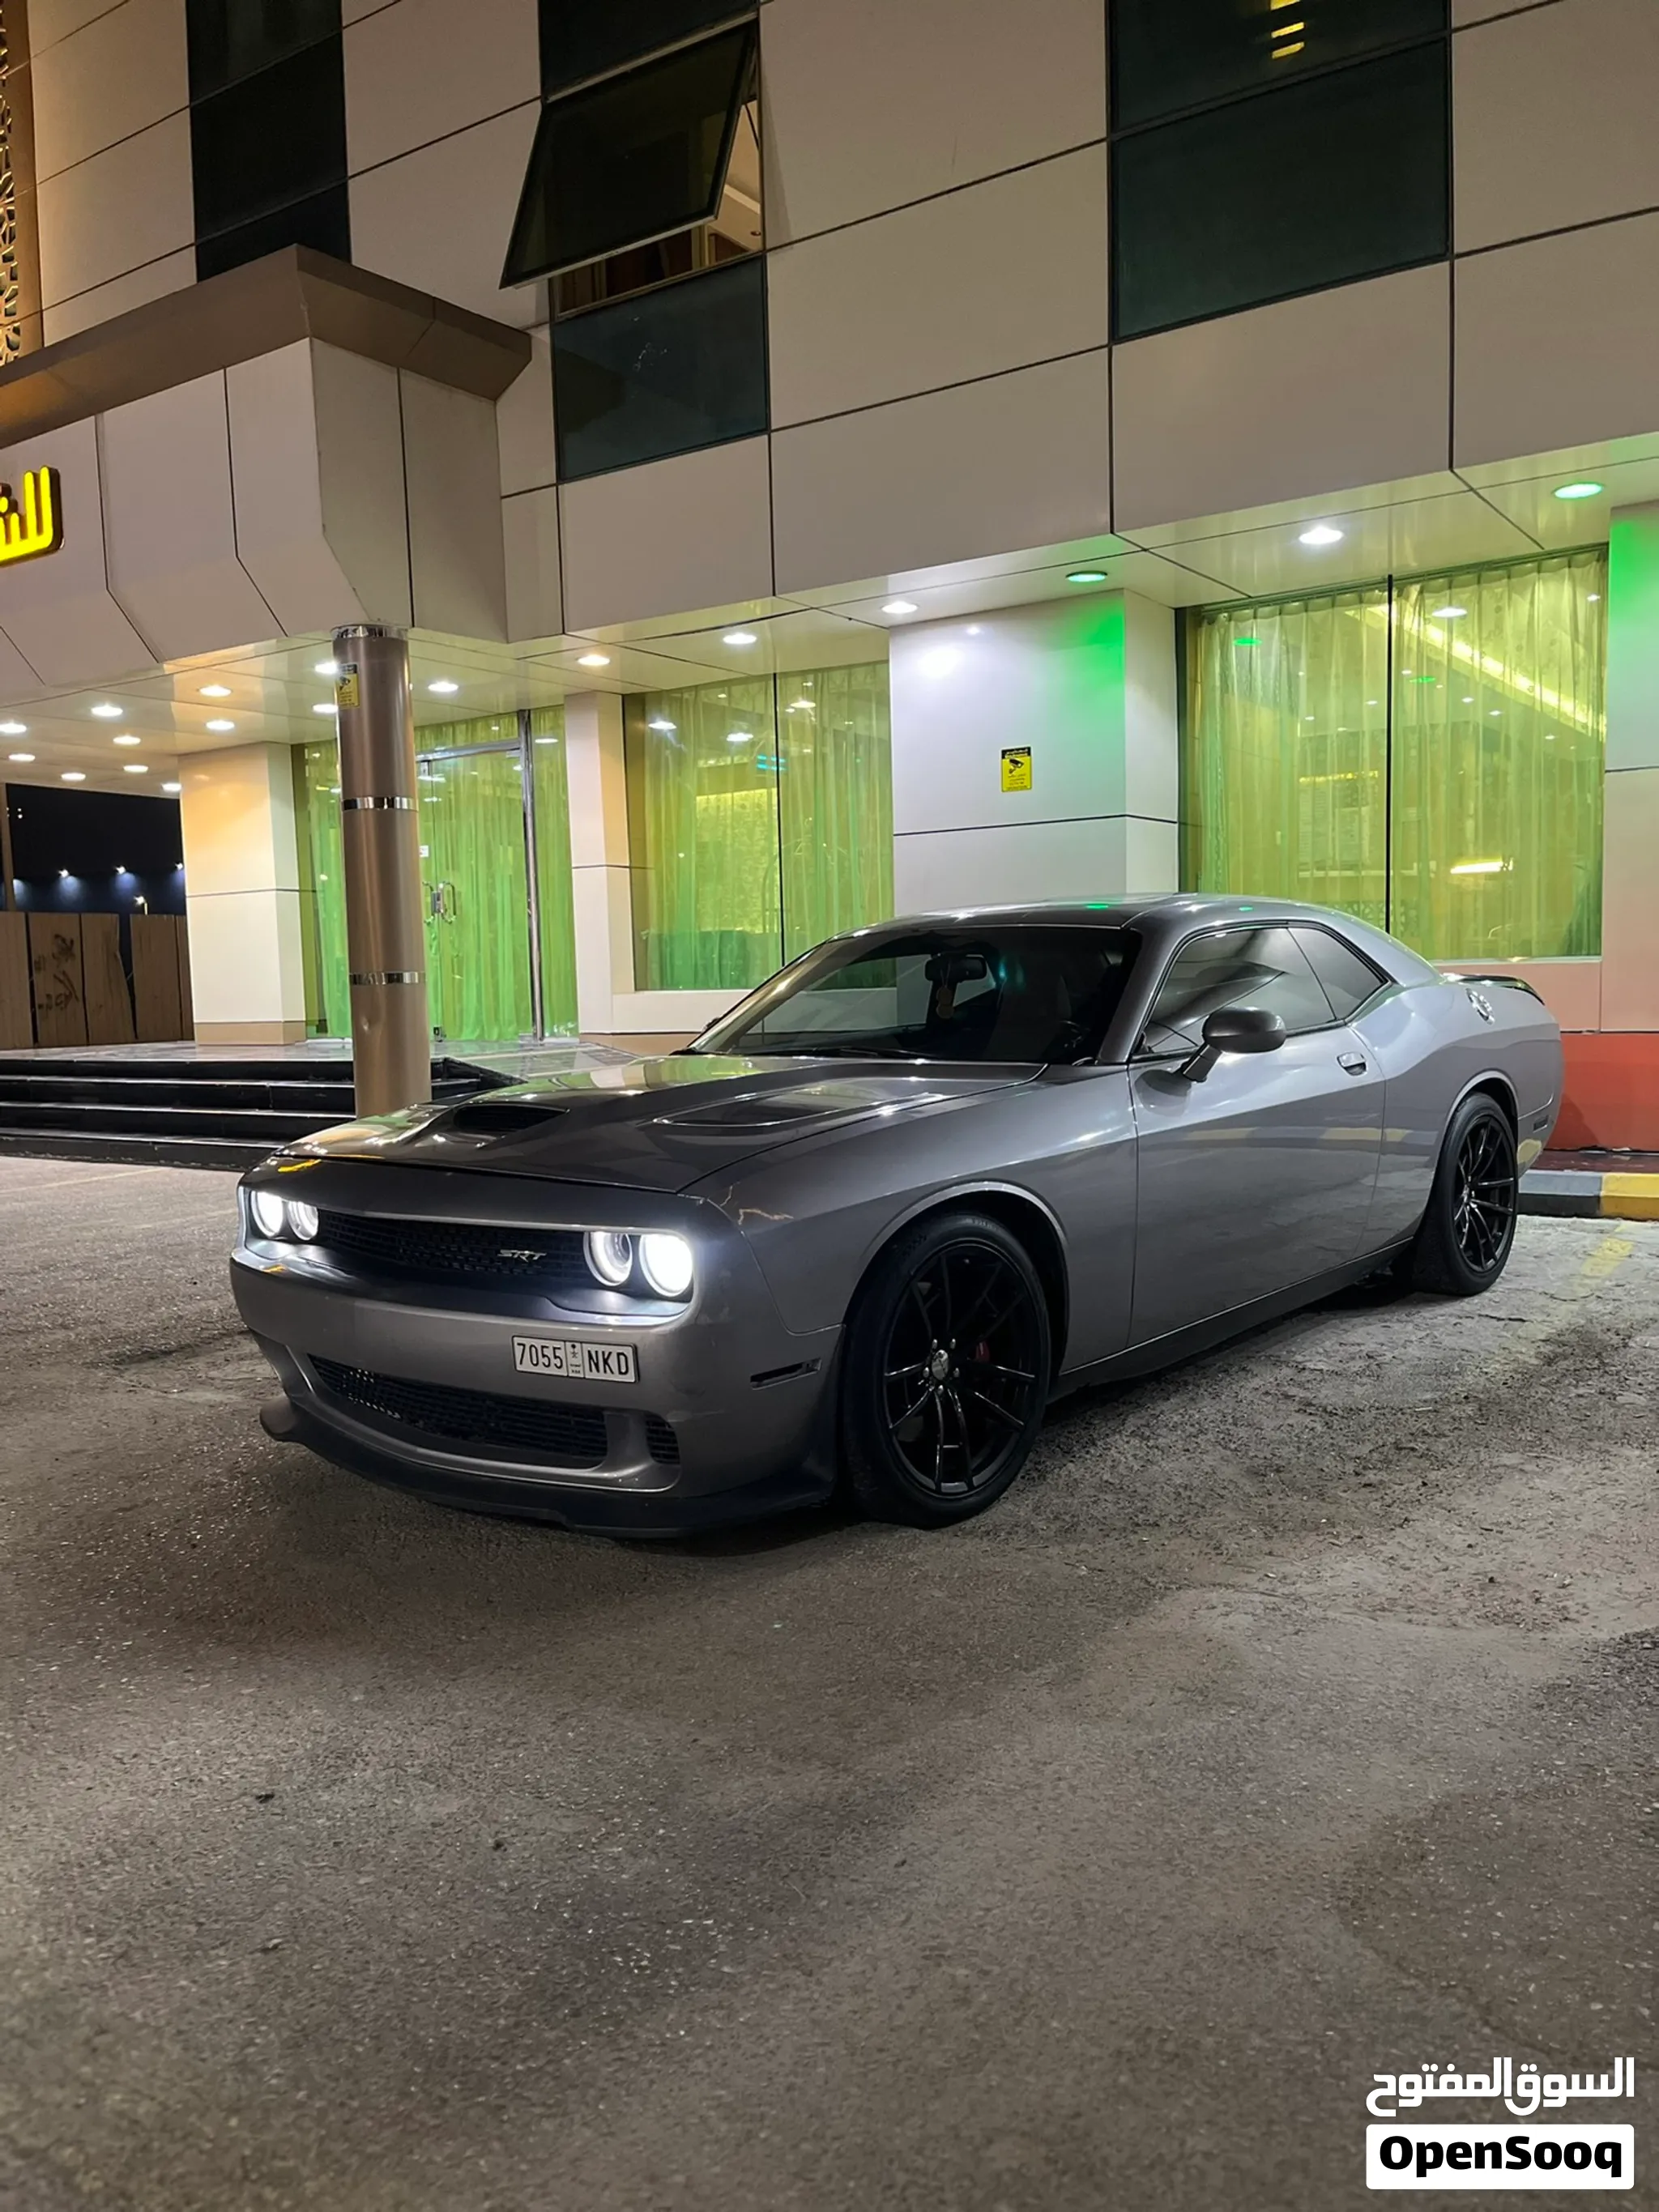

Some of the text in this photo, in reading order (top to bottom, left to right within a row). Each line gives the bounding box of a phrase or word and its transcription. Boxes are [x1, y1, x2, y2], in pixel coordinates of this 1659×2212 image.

[497, 1249, 547, 1262] SRT
[517, 1343, 629, 1375] 7055 NKD
